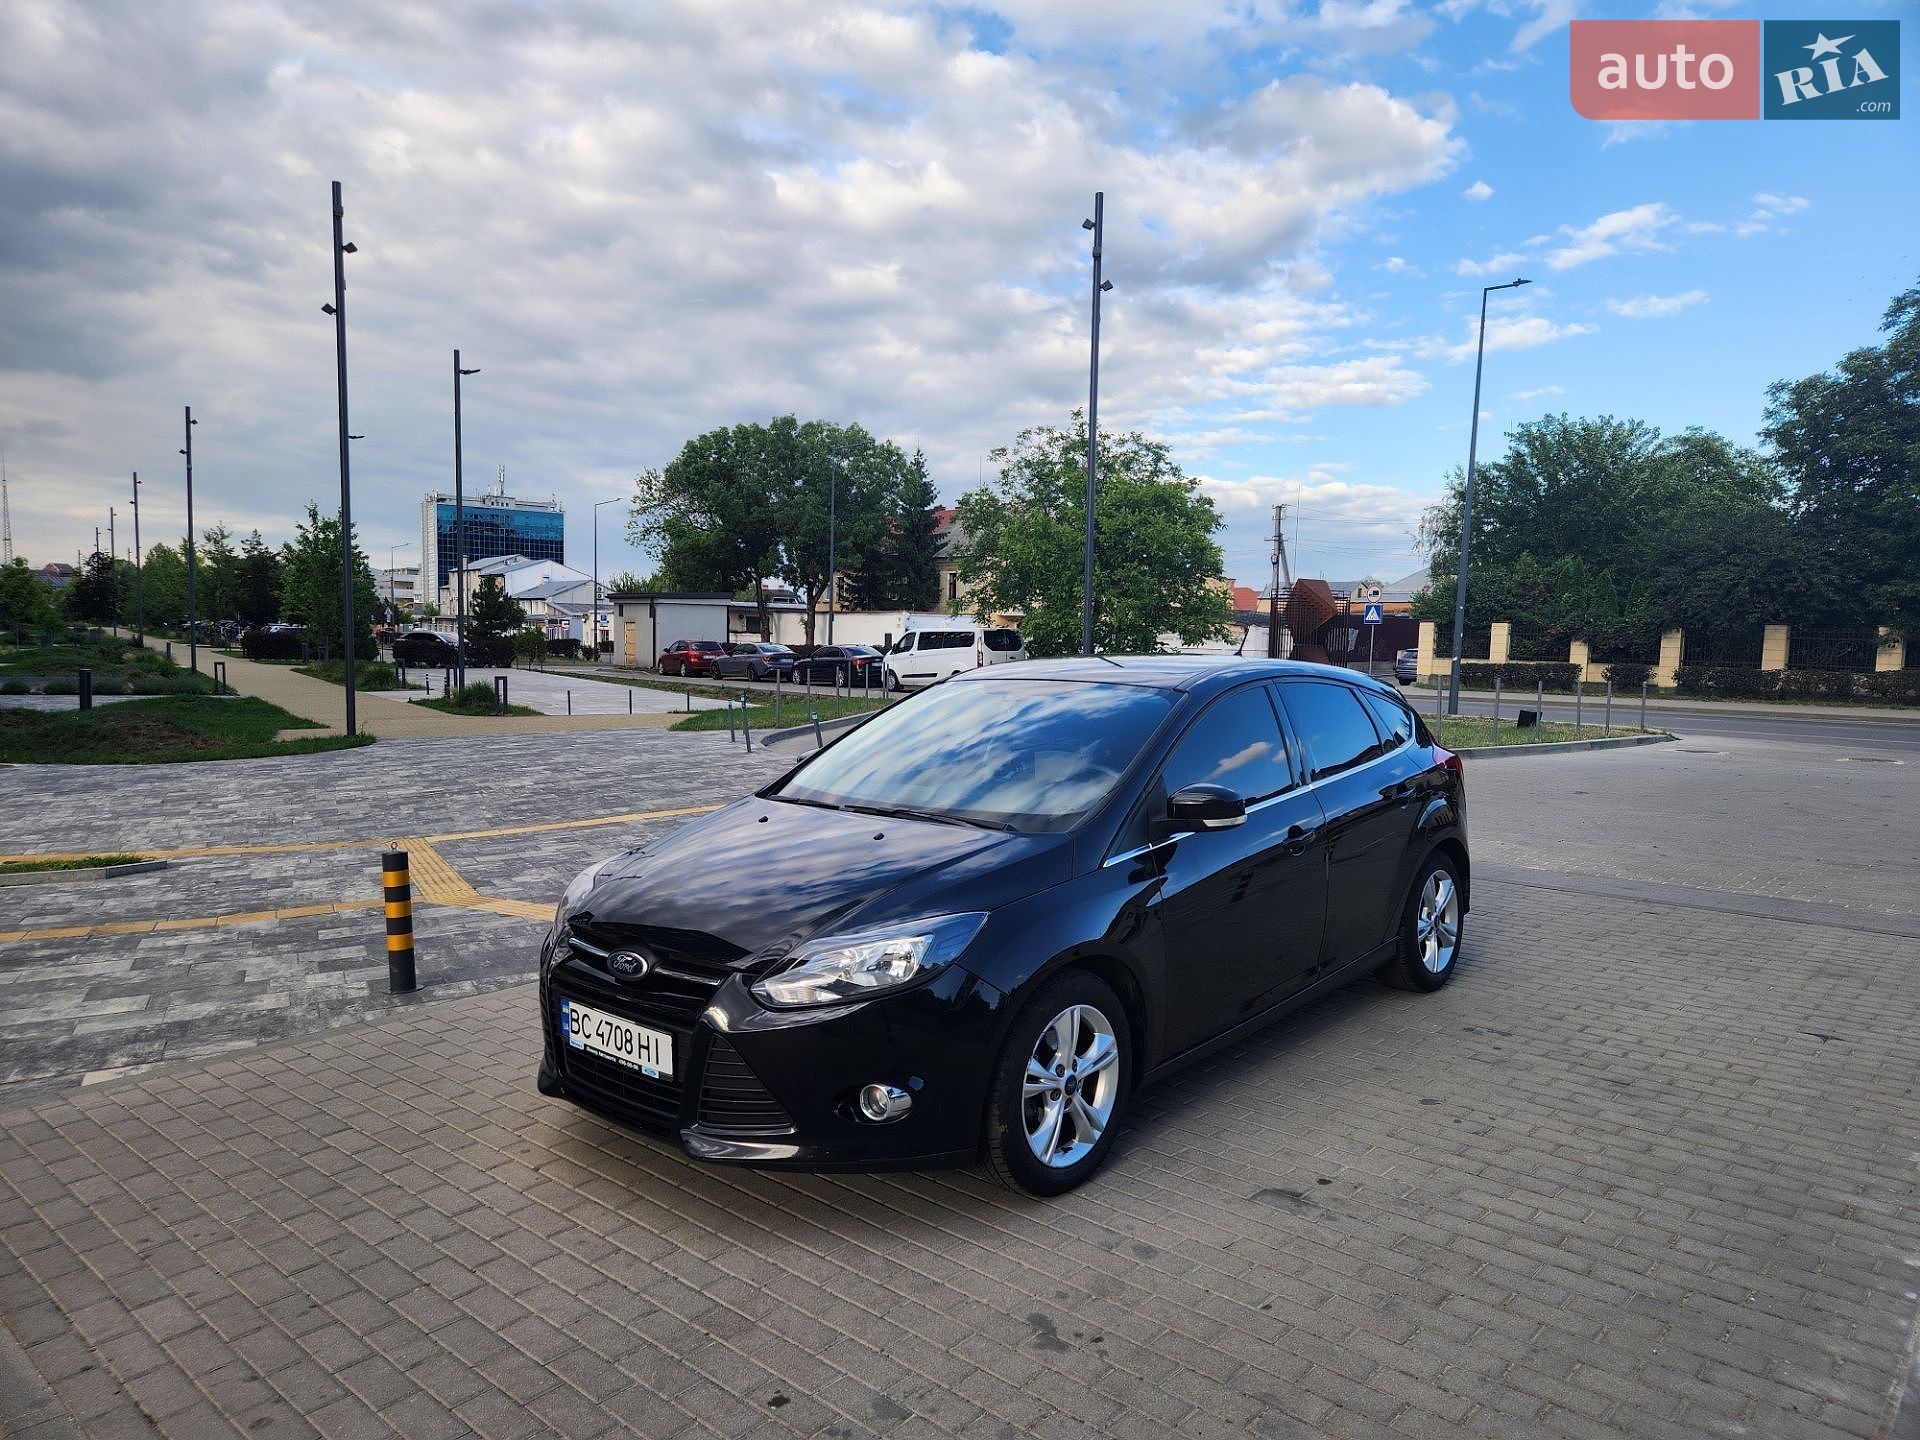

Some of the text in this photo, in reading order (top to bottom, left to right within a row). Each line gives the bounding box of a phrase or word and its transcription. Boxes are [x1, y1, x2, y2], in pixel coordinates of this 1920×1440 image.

[613, 954, 637, 973] Ford
[570, 1007, 592, 1039] BC
[595, 1019, 633, 1055] 4708
[638, 1032, 660, 1065] HI
